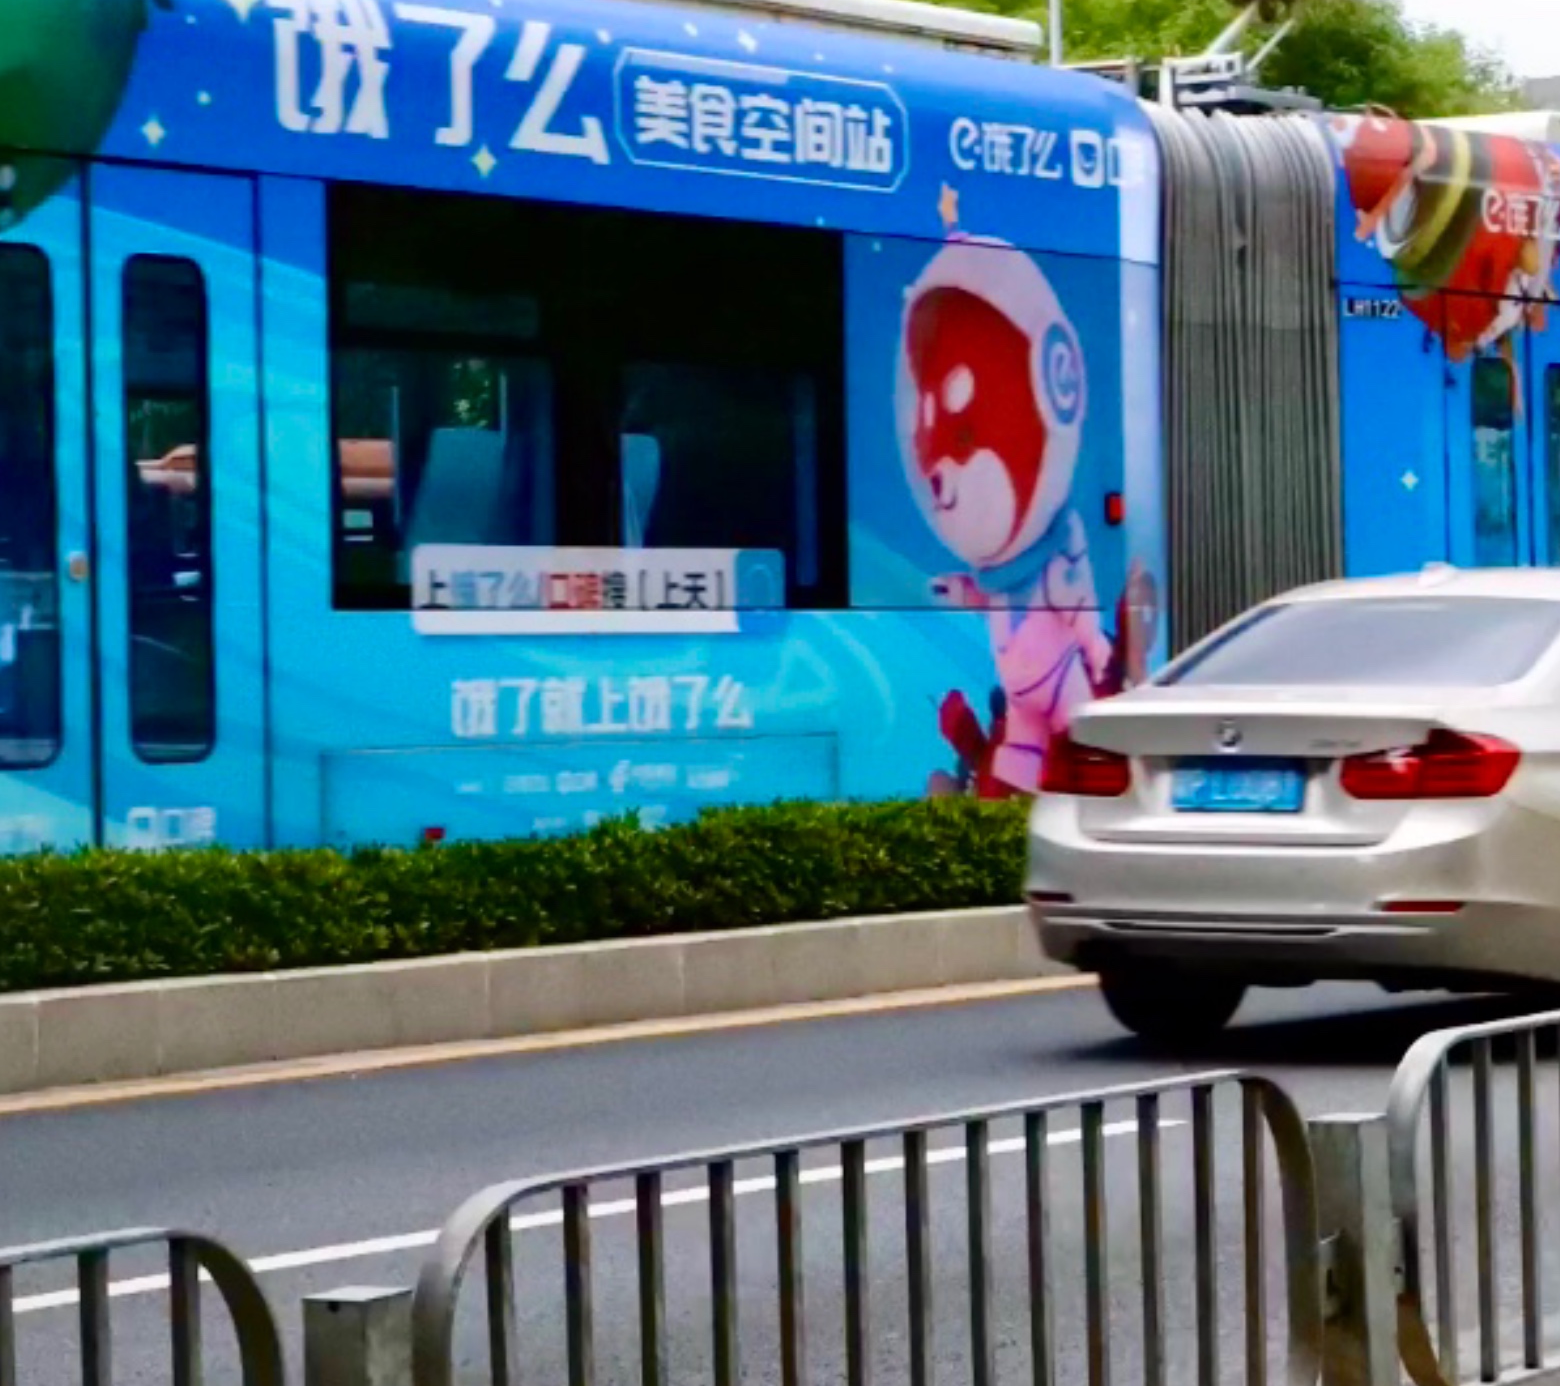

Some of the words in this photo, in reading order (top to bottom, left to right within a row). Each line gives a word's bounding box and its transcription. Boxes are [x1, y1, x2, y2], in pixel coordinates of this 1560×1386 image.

[633, 74, 892, 174] 美食空间站
[450, 673, 755, 739] 饿了就上饿了么
